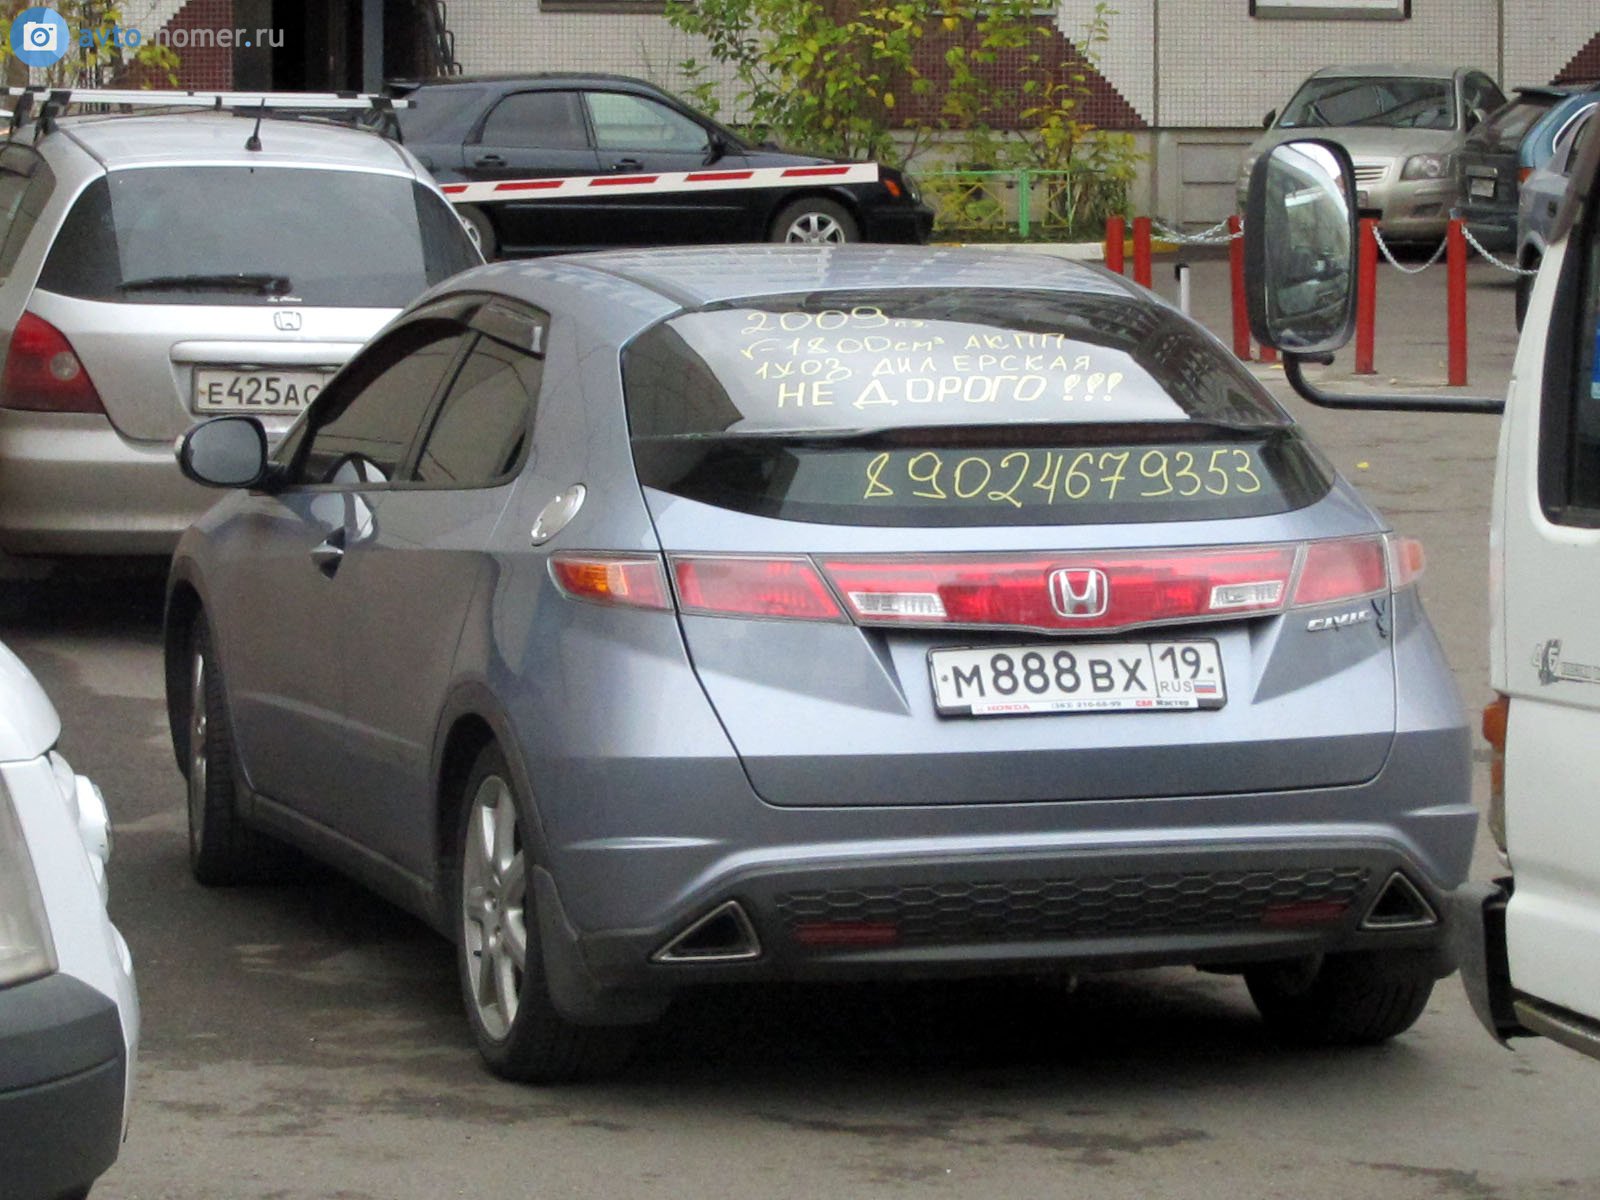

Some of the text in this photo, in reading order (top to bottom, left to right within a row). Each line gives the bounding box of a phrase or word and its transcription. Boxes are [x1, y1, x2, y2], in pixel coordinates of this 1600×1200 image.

[741, 306, 889, 334] 2009
[964, 332, 1066, 350] АКПП
[777, 381, 836, 408] НЕ
[1307, 609, 1371, 632] CIVIC
[1160, 646, 1201, 680] 19
[1160, 680, 1193, 693] RUS
[986, 704, 1031, 713] HONDA
